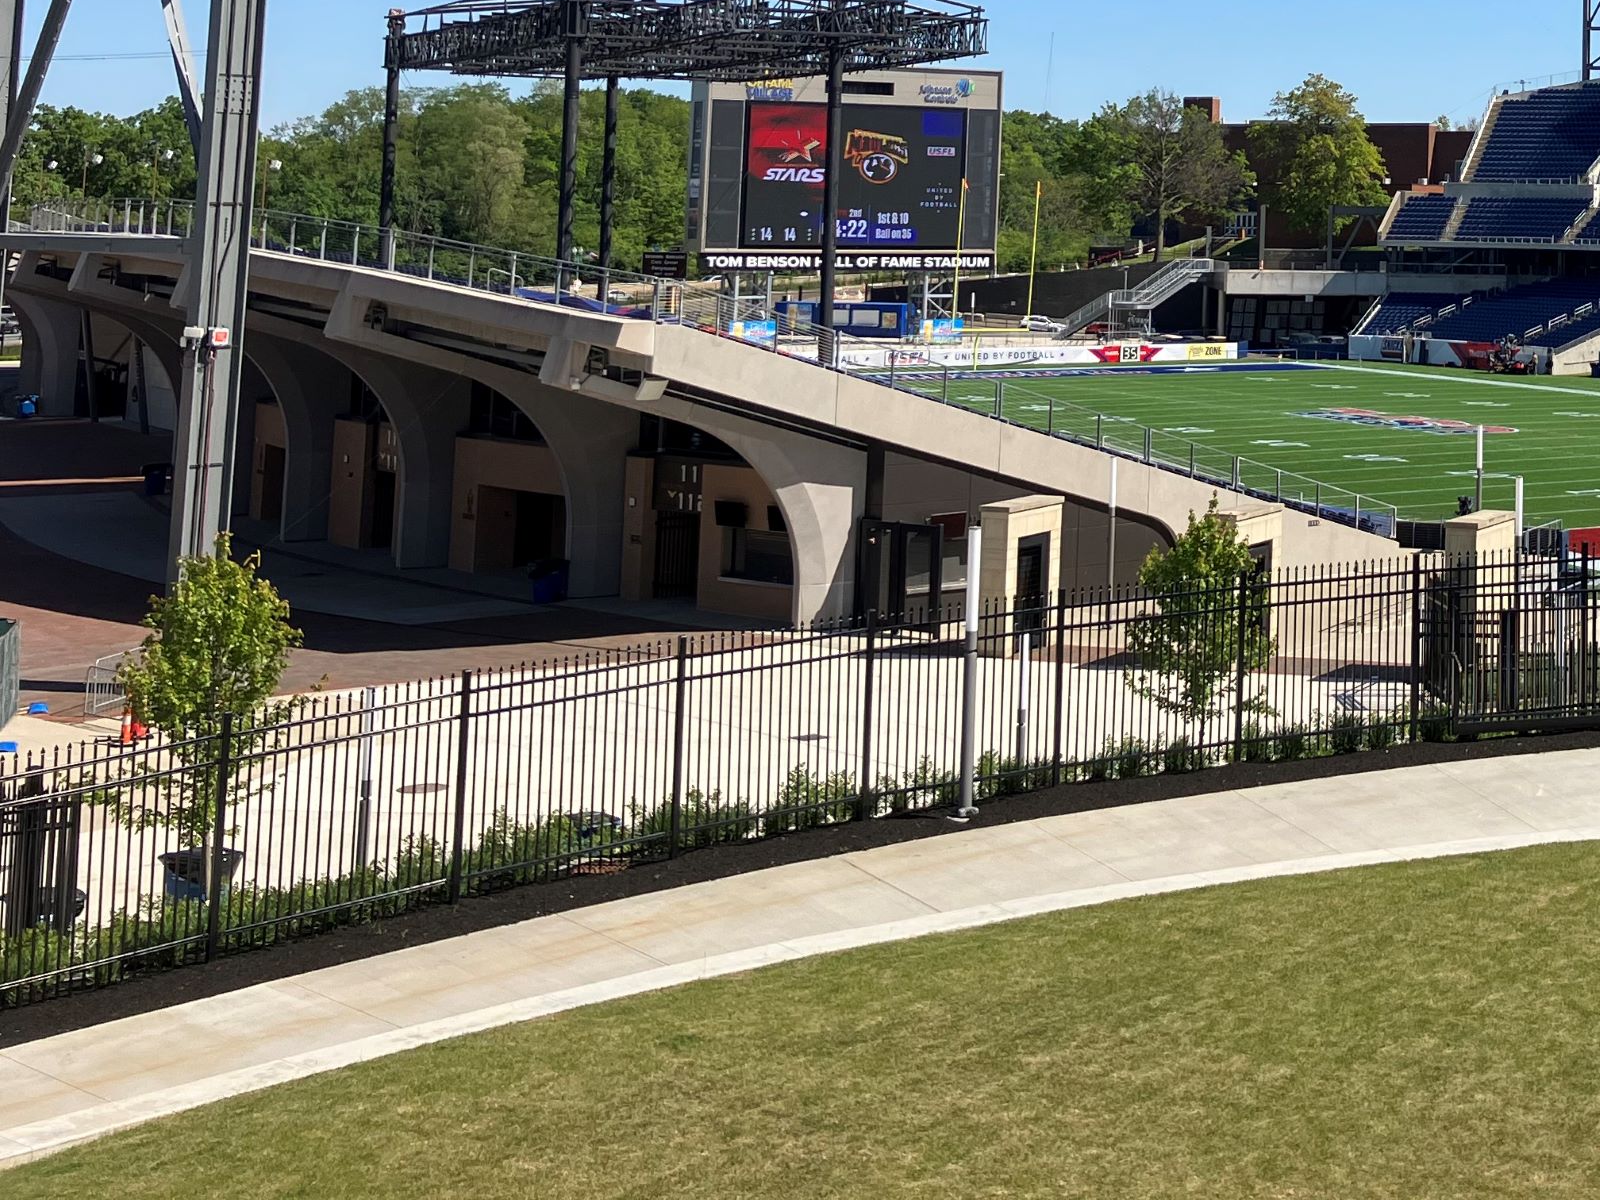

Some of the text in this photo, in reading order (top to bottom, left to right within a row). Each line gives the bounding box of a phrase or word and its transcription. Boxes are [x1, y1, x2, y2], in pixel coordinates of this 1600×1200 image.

[928, 147, 955, 156] USFL
[763, 168, 826, 182] STARS
[760, 227, 773, 241] 14
[784, 227, 796, 241] 14
[706, 256, 990, 268] TOM BENSON HLL OF FAME STADIUM
[887, 351, 928, 364] USFL
[992, 352, 1005, 360] BY
[1007, 351, 1055, 359] FOOTBALL
[1123, 347, 1138, 360] 35
[1205, 346, 1222, 356] ZONE
